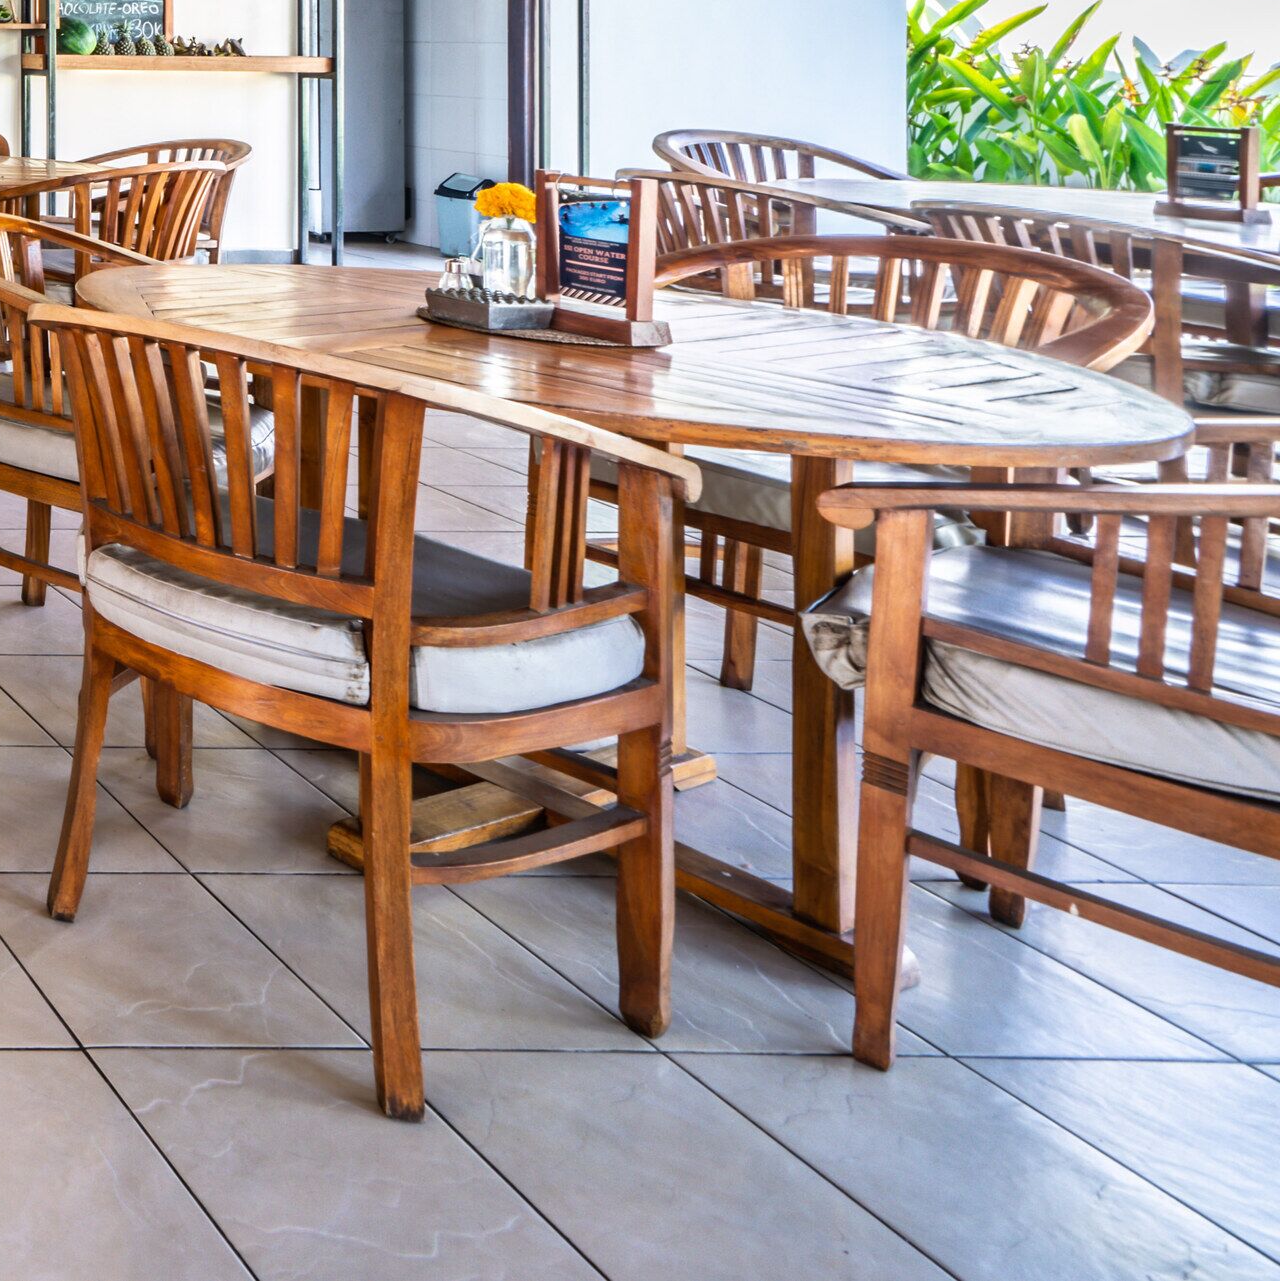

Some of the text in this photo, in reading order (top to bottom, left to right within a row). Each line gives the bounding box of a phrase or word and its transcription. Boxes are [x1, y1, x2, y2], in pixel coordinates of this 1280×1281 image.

[59, 2, 159, 16] HOCOLATE-OREO
[573, 246, 593, 255] OPEN
[595, 249, 626, 260] WATER
[578, 253, 609, 264] COURSE
